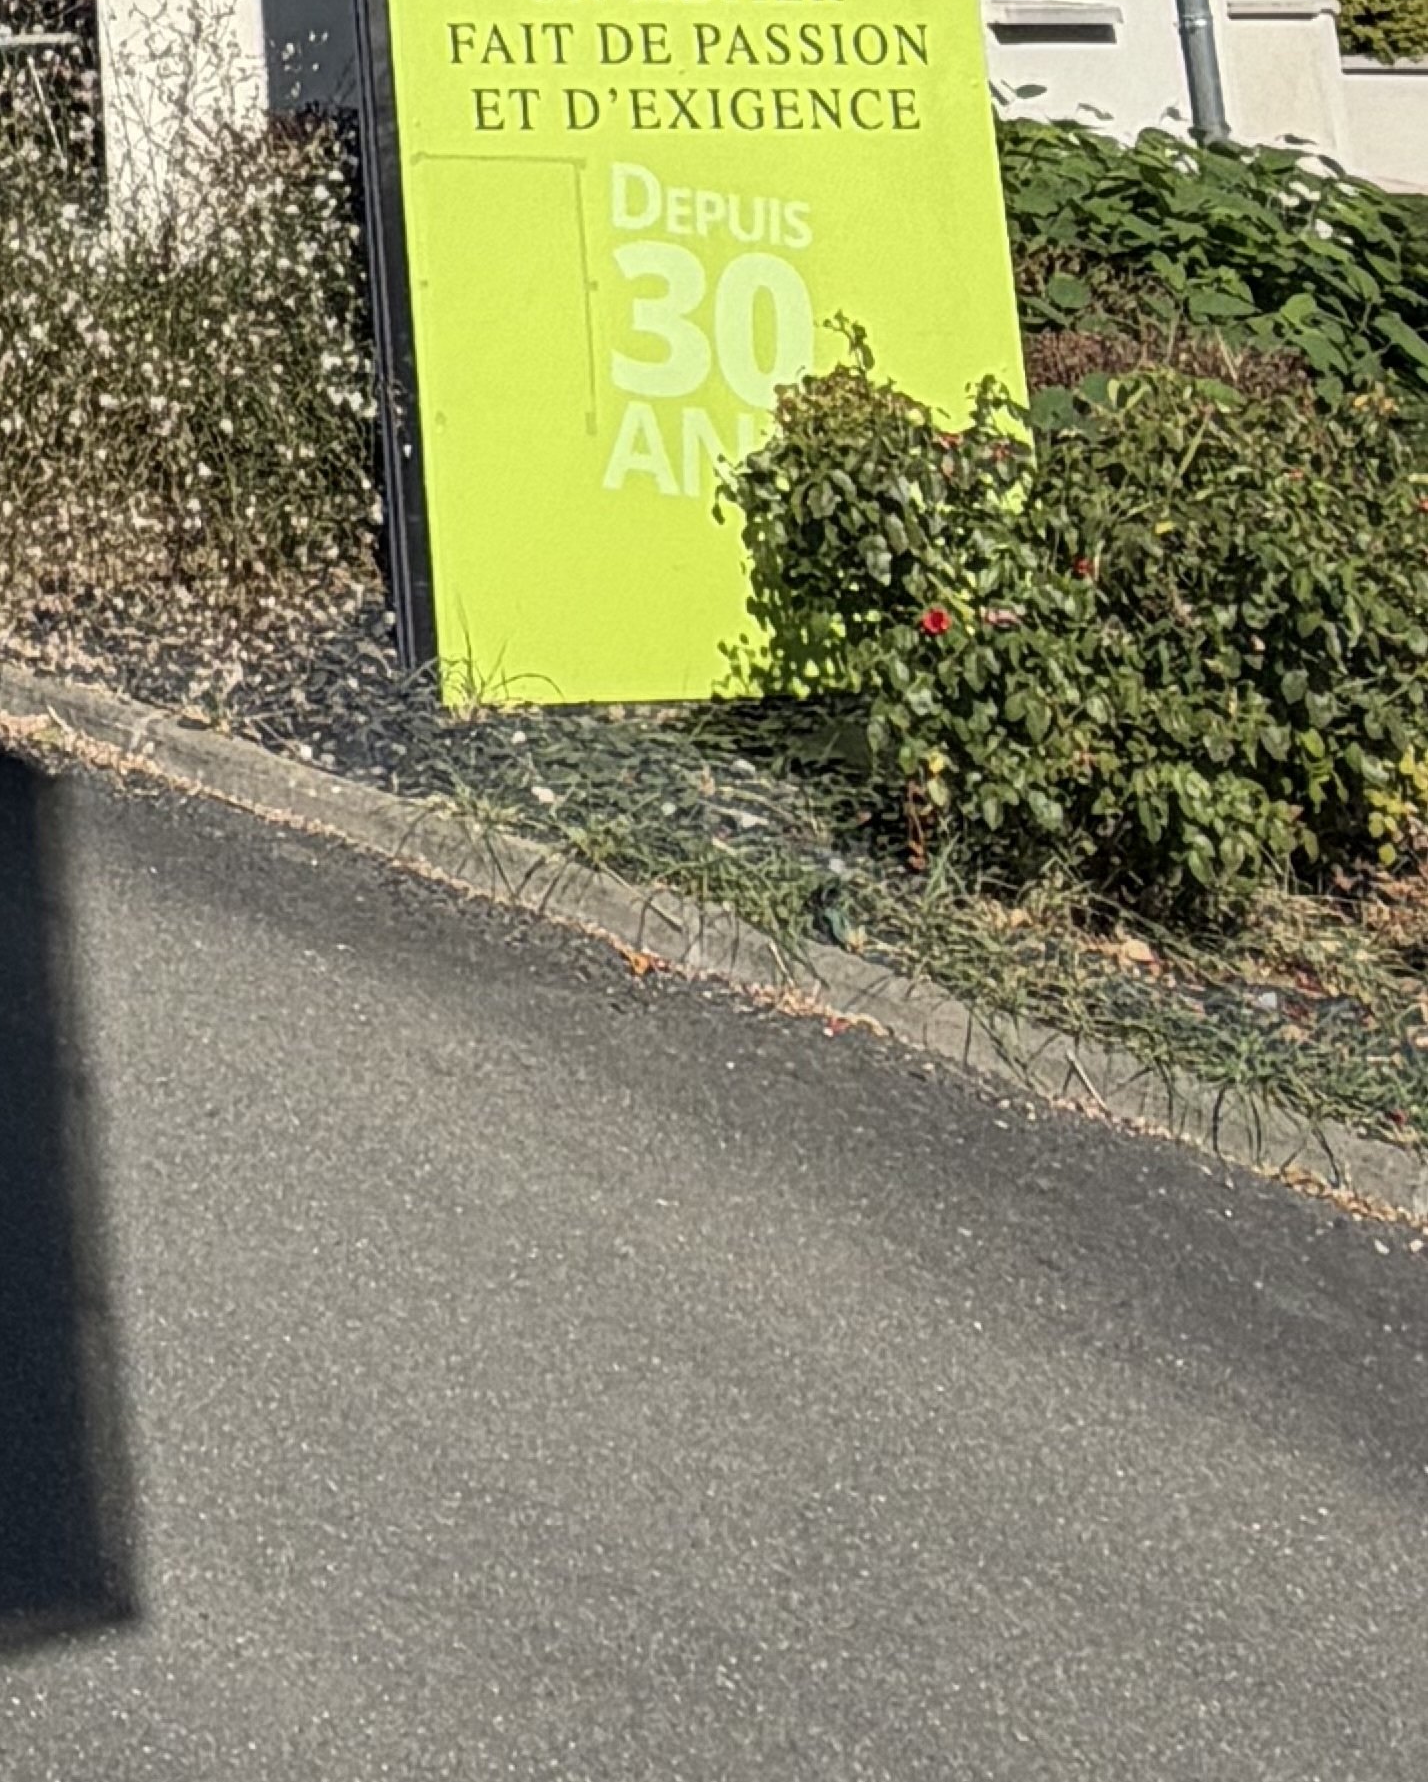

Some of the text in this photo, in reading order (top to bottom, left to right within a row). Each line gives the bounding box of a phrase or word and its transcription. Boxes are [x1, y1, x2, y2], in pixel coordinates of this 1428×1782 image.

[449, 23, 927, 65] FAIT DE PASSION
[473, 89, 539, 129] ET
[610, 239, 815, 410] 30
[602, 400, 756, 499] AN
